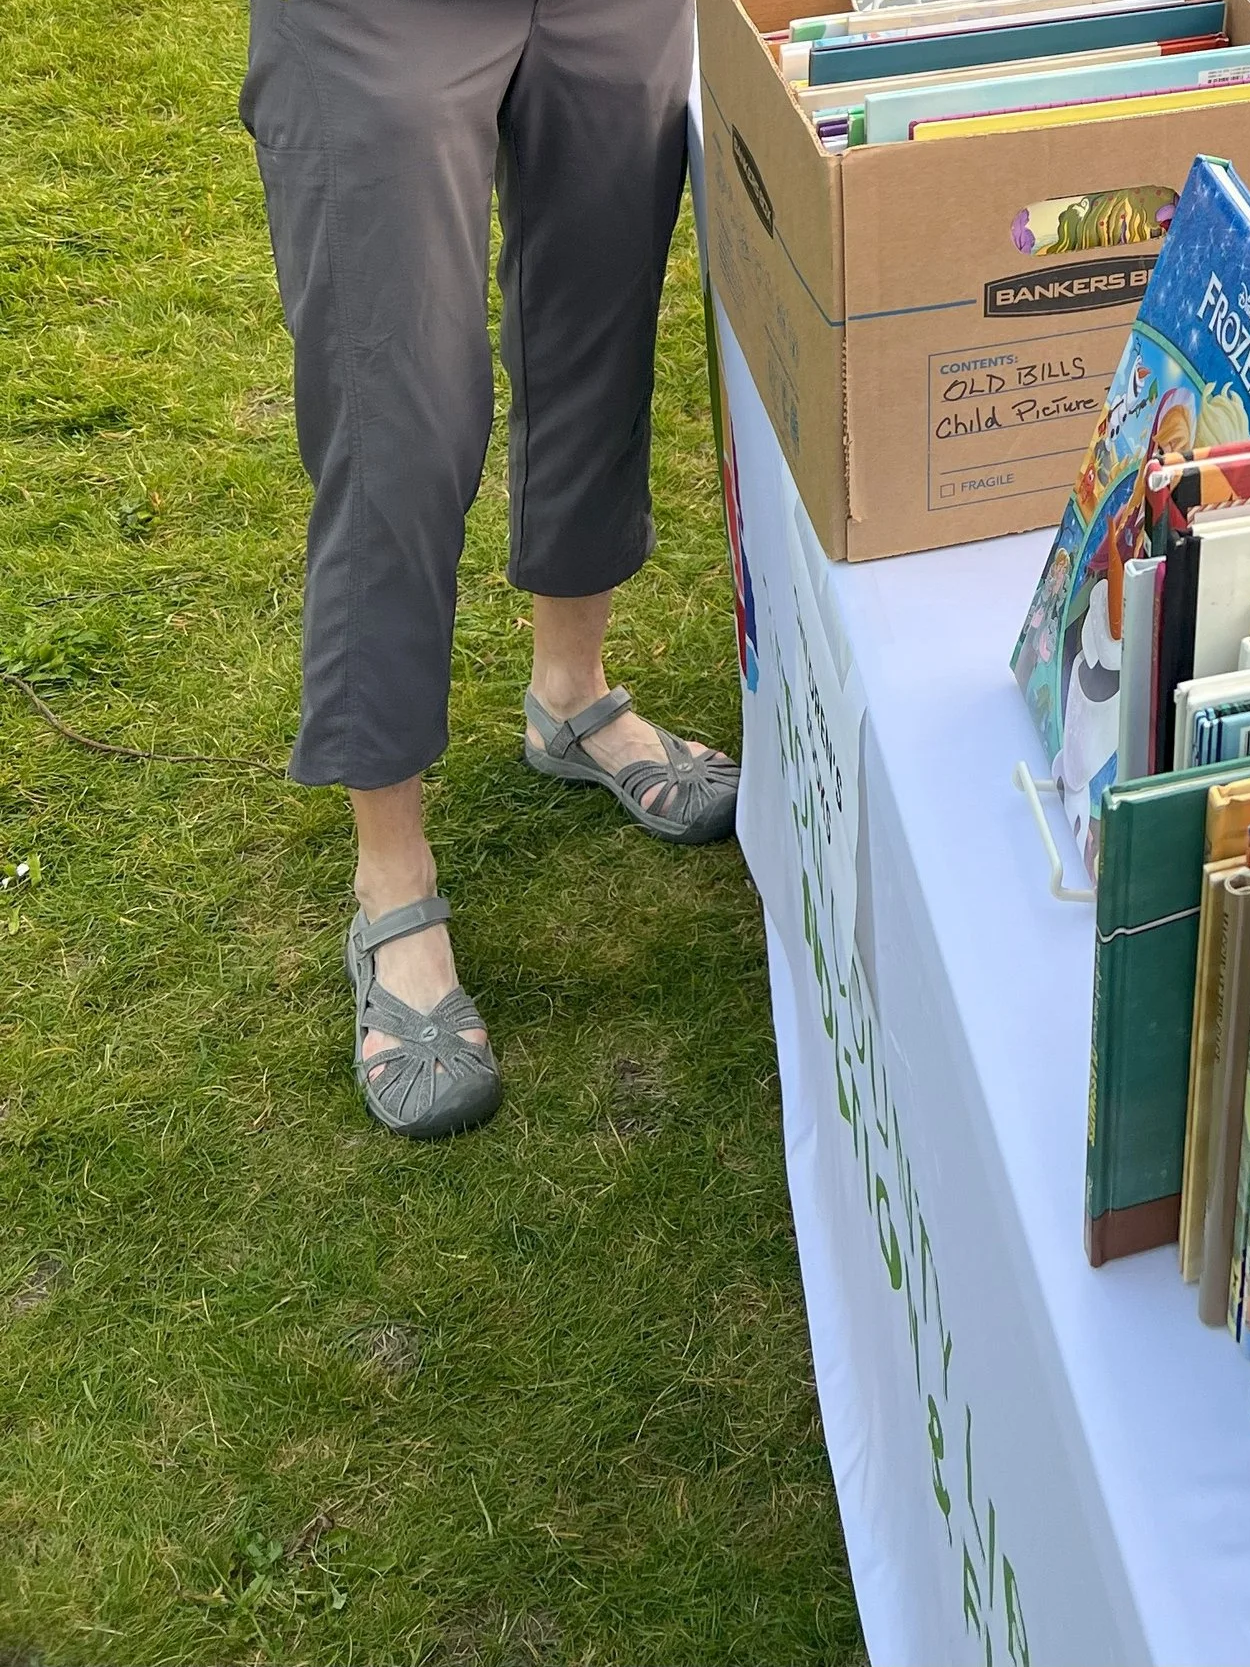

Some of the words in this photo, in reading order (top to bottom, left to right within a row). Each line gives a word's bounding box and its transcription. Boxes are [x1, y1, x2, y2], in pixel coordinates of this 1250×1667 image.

[996, 272, 1126, 306] BANKERS
[940, 354, 1019, 375] CONTENTS:
[942, 374, 1006, 402] OLD
[1017, 357, 1086, 386] BILLS
[935, 407, 1002, 440] Child
[1011, 396, 1100, 423] Picture
[960, 473, 1016, 492] FRAGILE
